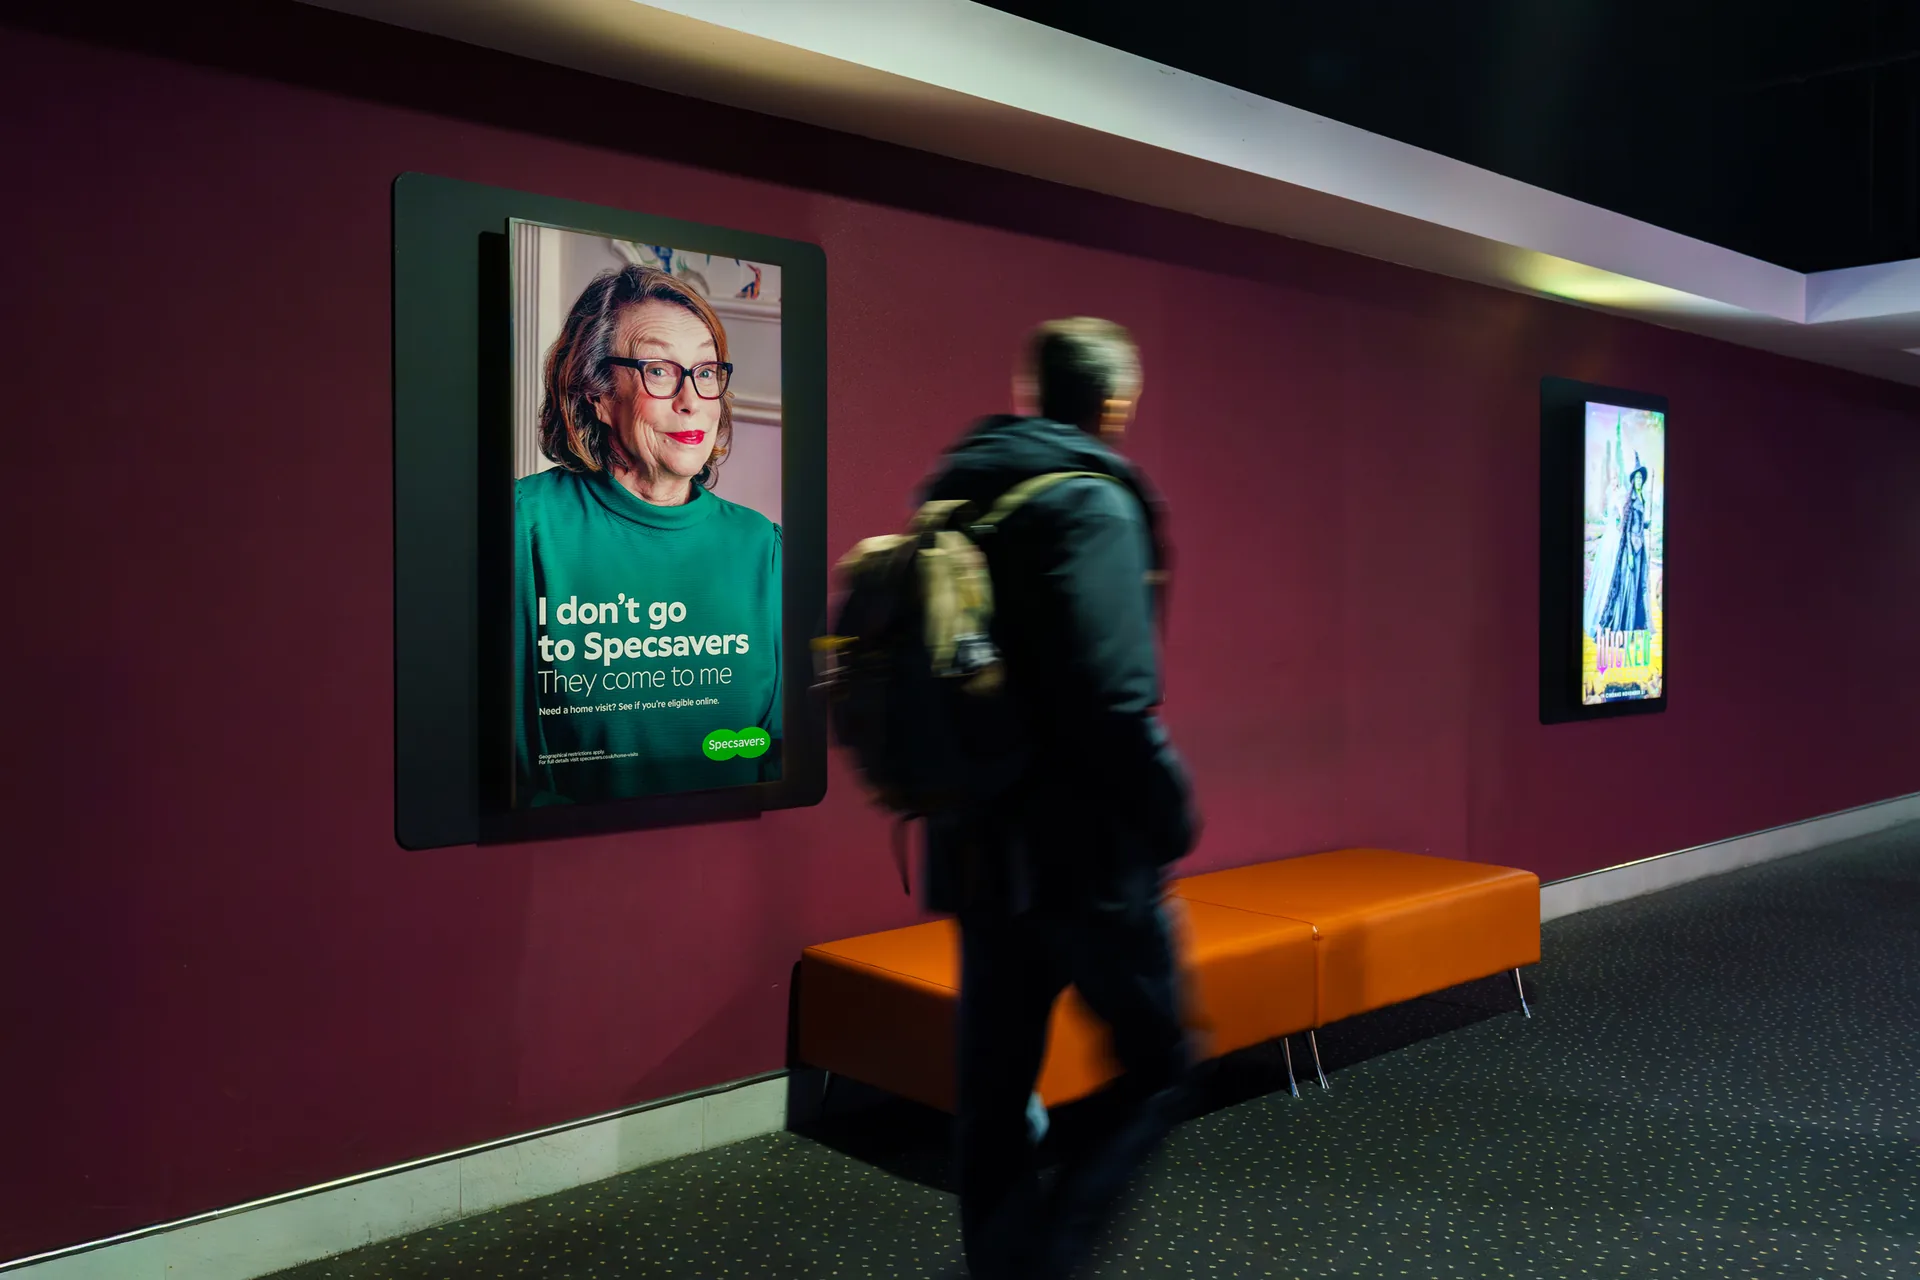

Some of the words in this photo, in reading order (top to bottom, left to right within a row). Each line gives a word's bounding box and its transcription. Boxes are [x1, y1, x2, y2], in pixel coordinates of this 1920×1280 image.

[539, 597, 546, 625] I
[556, 593, 640, 624] don't
[648, 602, 687, 630] go
[538, 635, 575, 662] to
[584, 632, 749, 666] Specsavers
[1596, 626, 1651, 674] WICKED
[538, 669, 597, 697] They
[602, 670, 666, 691] come
[671, 666, 694, 687] to
[700, 667, 732, 685] me
[539, 706, 561, 716] Need
[570, 706, 593, 714] home
[595, 703, 616, 712] visit?
[618, 702, 632, 711] See
[634, 701, 640, 710] if
[642, 700, 666, 710] you're
[668, 698, 694, 709] eligible
[696, 697, 720, 706] online.
[708, 737, 765, 751] Specsavers
